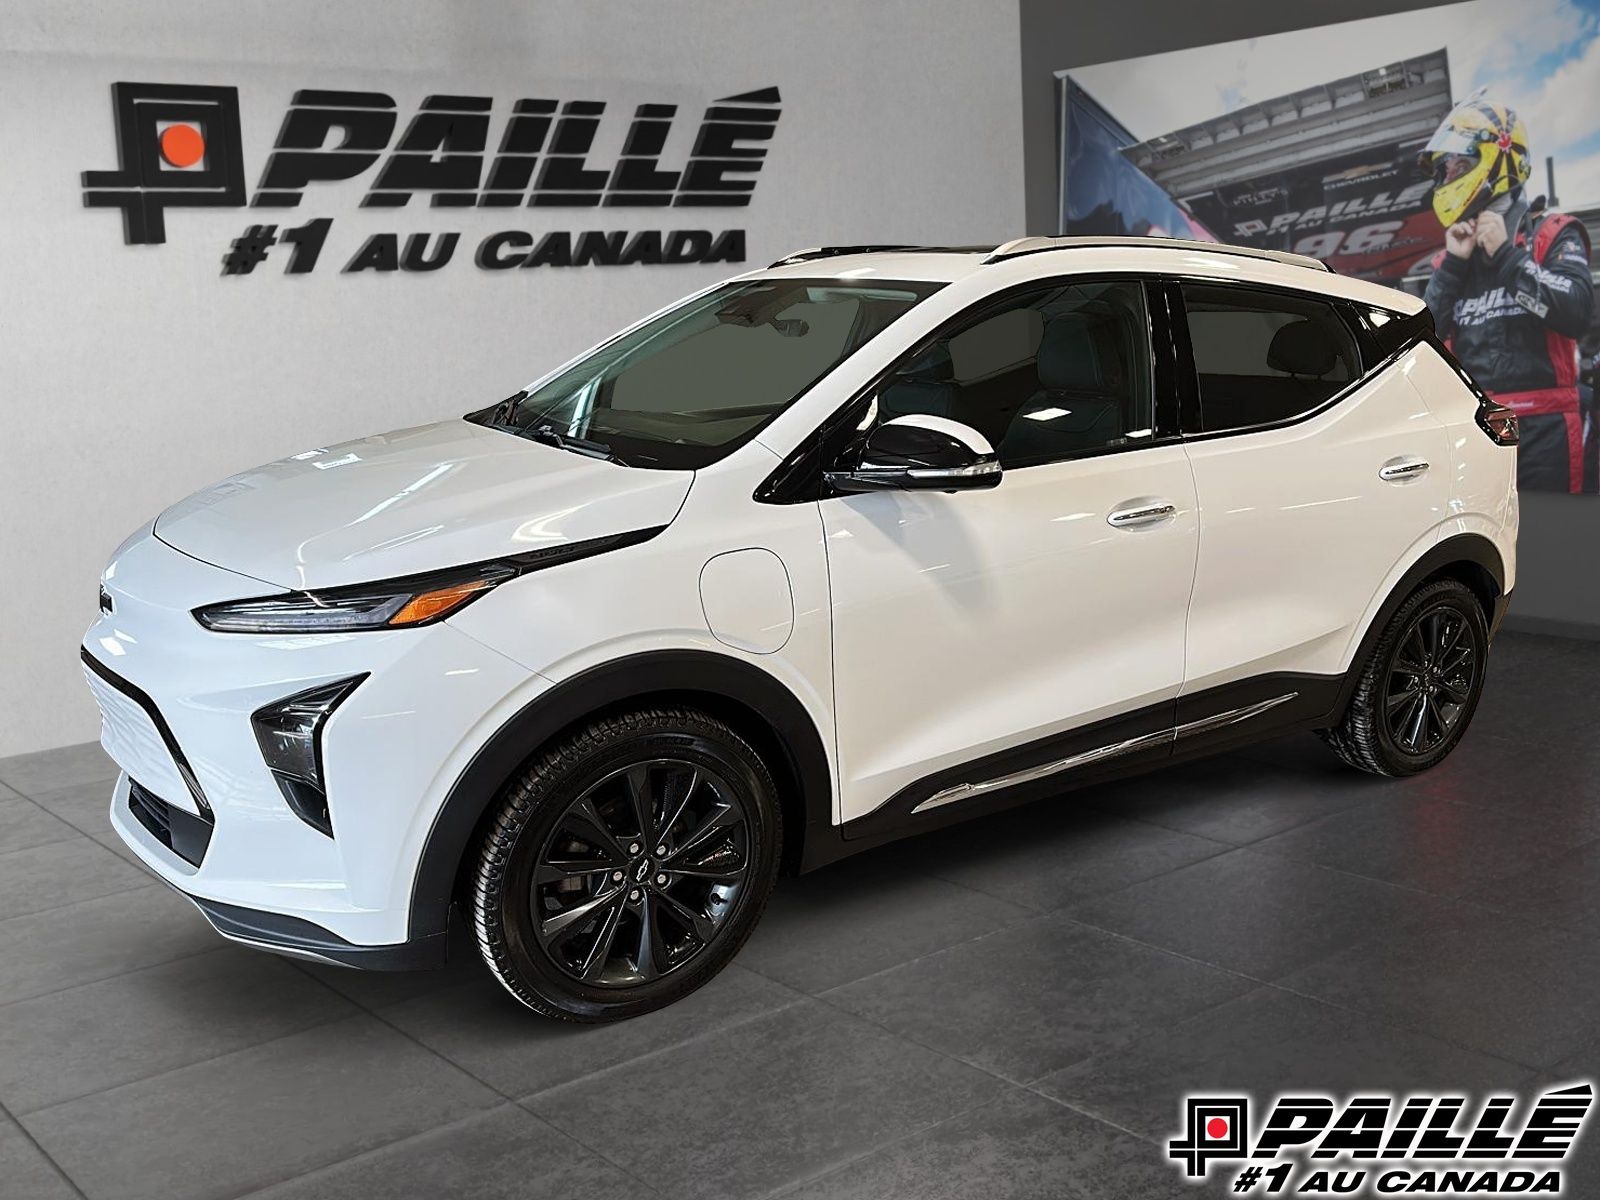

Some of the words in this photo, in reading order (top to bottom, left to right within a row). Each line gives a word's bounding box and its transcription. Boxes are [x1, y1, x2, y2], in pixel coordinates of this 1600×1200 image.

[249, 86, 781, 208] PAILLÉ
[220, 217, 334, 276] #1
[341, 232, 460, 273] AU
[475, 229, 746, 271] CANADA
[1293, 220, 1403, 259] 96
